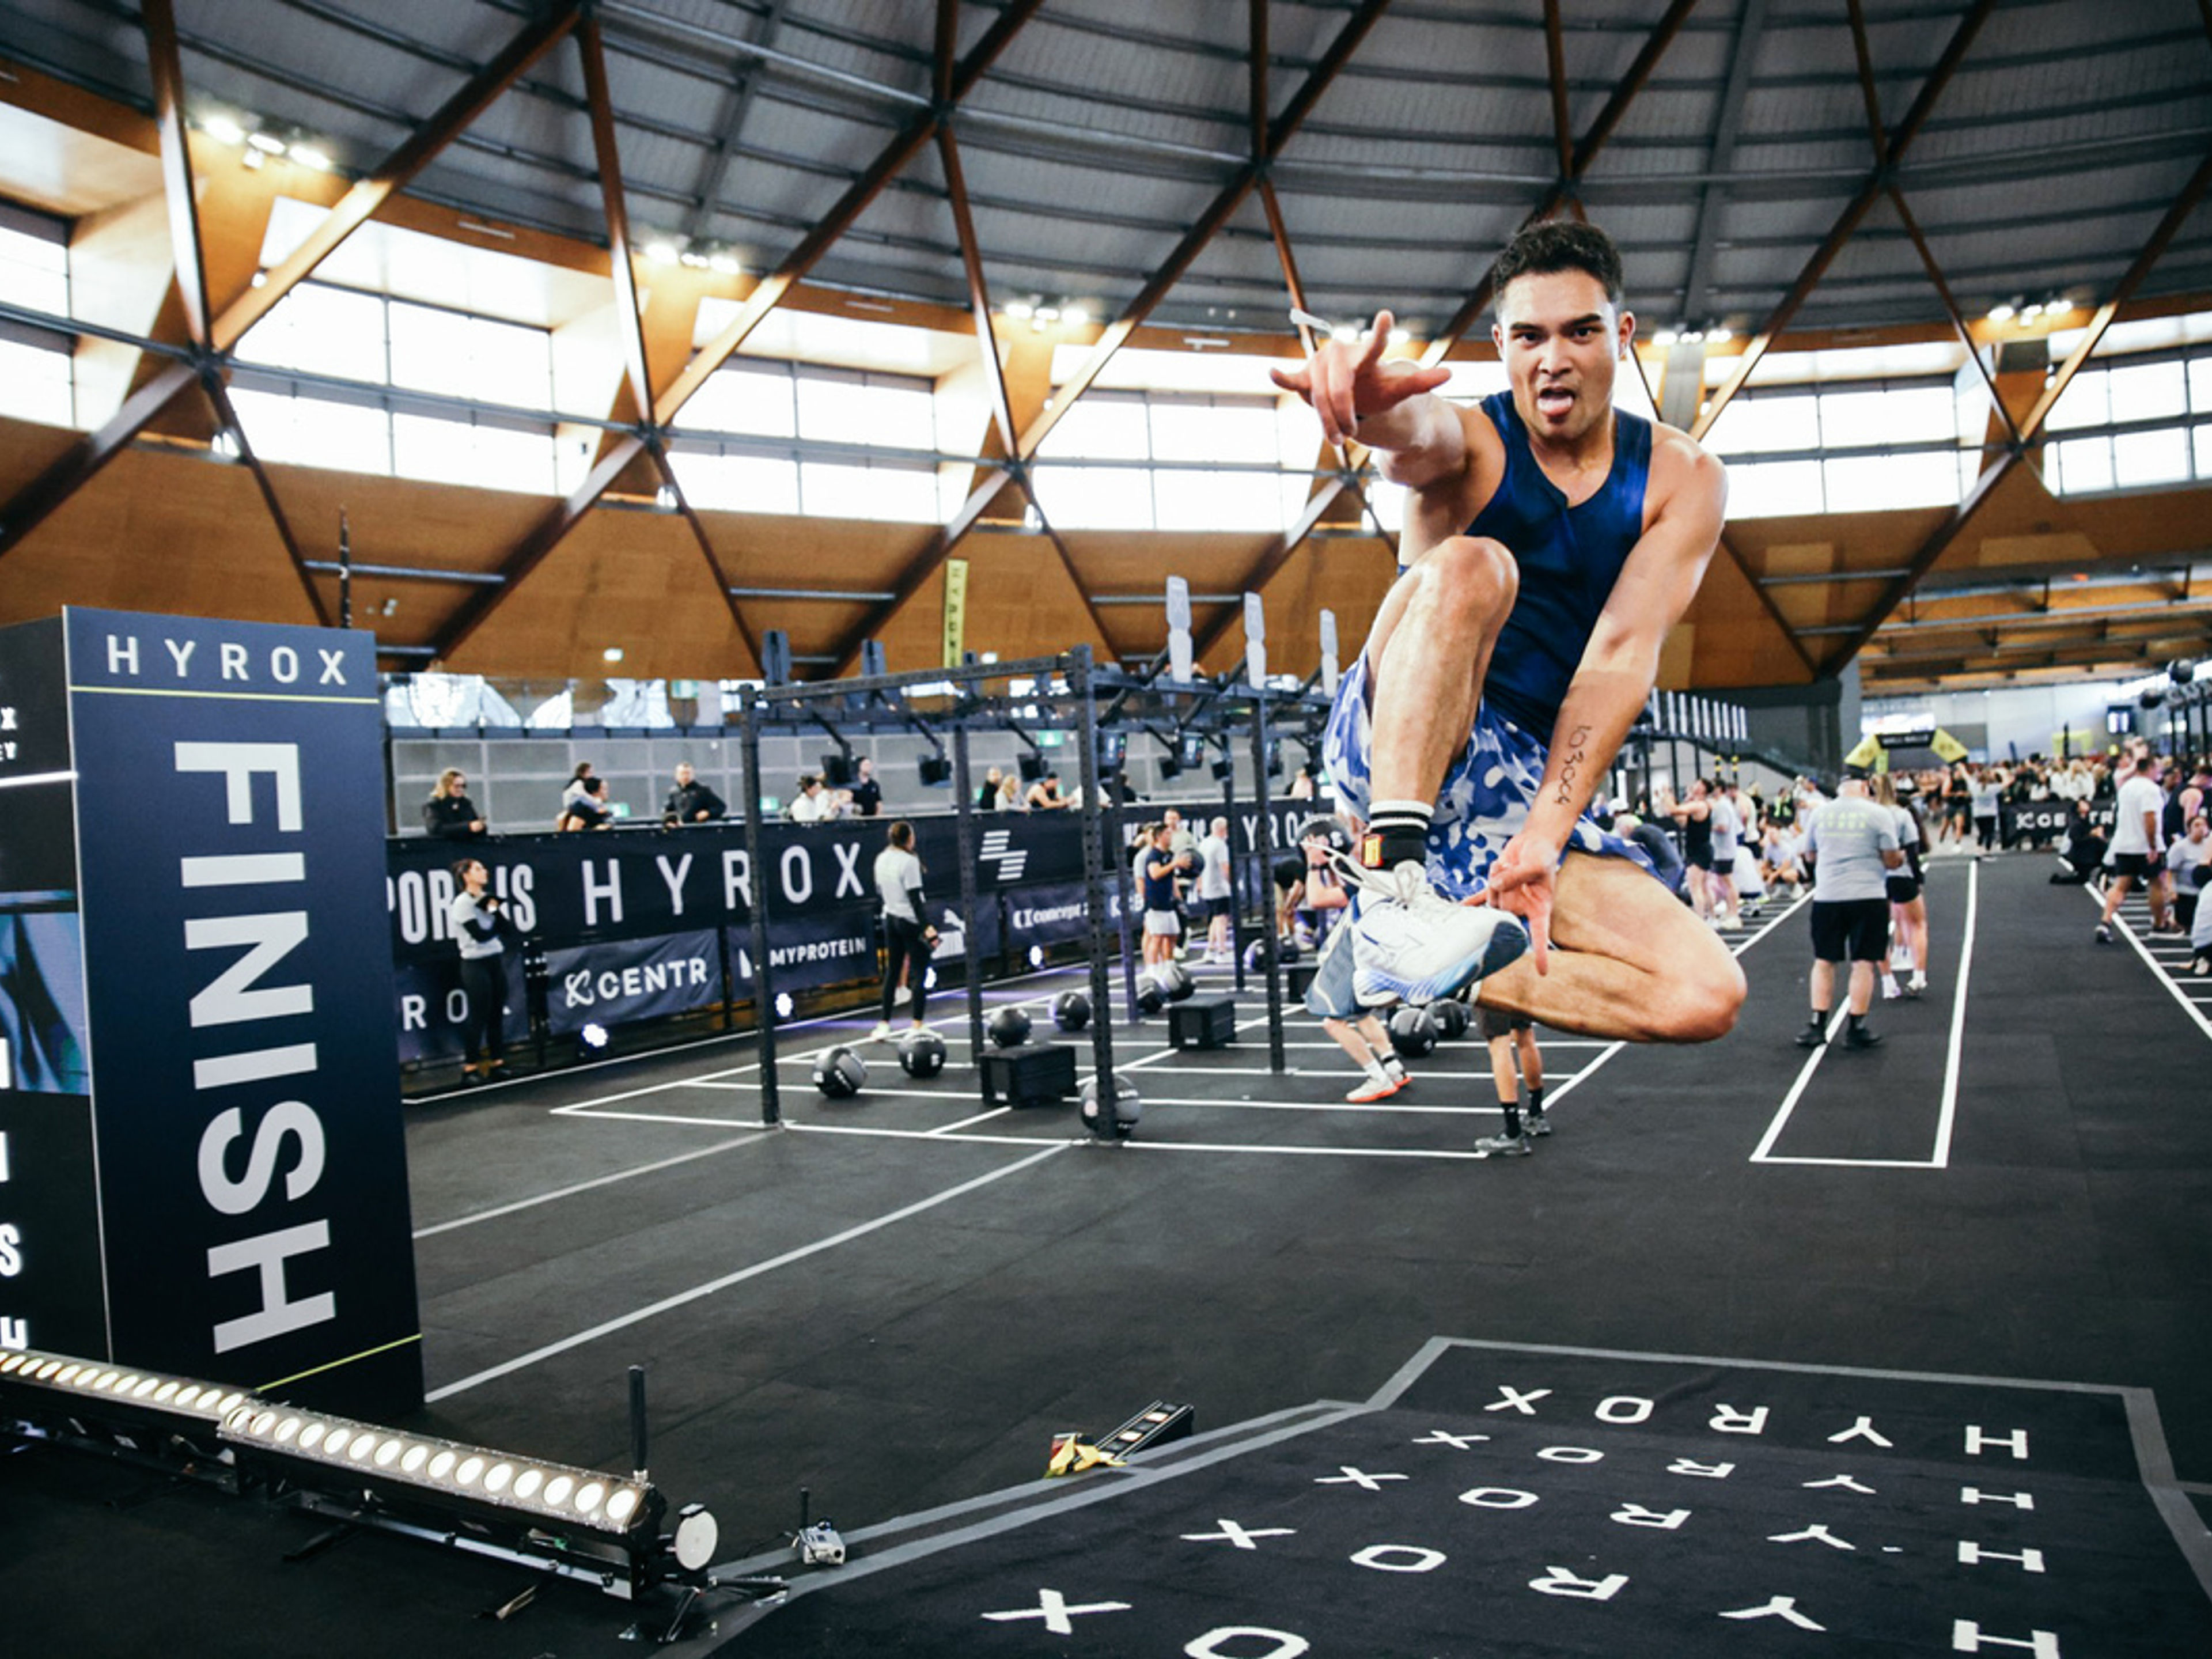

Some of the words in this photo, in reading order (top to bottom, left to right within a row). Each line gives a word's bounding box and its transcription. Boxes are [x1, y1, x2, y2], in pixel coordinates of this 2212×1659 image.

[107, 634, 347, 686] HYROX
[582, 842, 864, 926] HYROX
[598, 957, 707, 999] CENTR
[770, 937, 866, 967] MYPROTEIN
[174, 741, 336, 1353] FINISH
[1484, 1386, 2028, 1459] HYROX
[1412, 1430, 2034, 1509] HYROX
[1314, 1466, 2045, 1572] HYROX
[1180, 1519, 2060, 1659] HYROX
